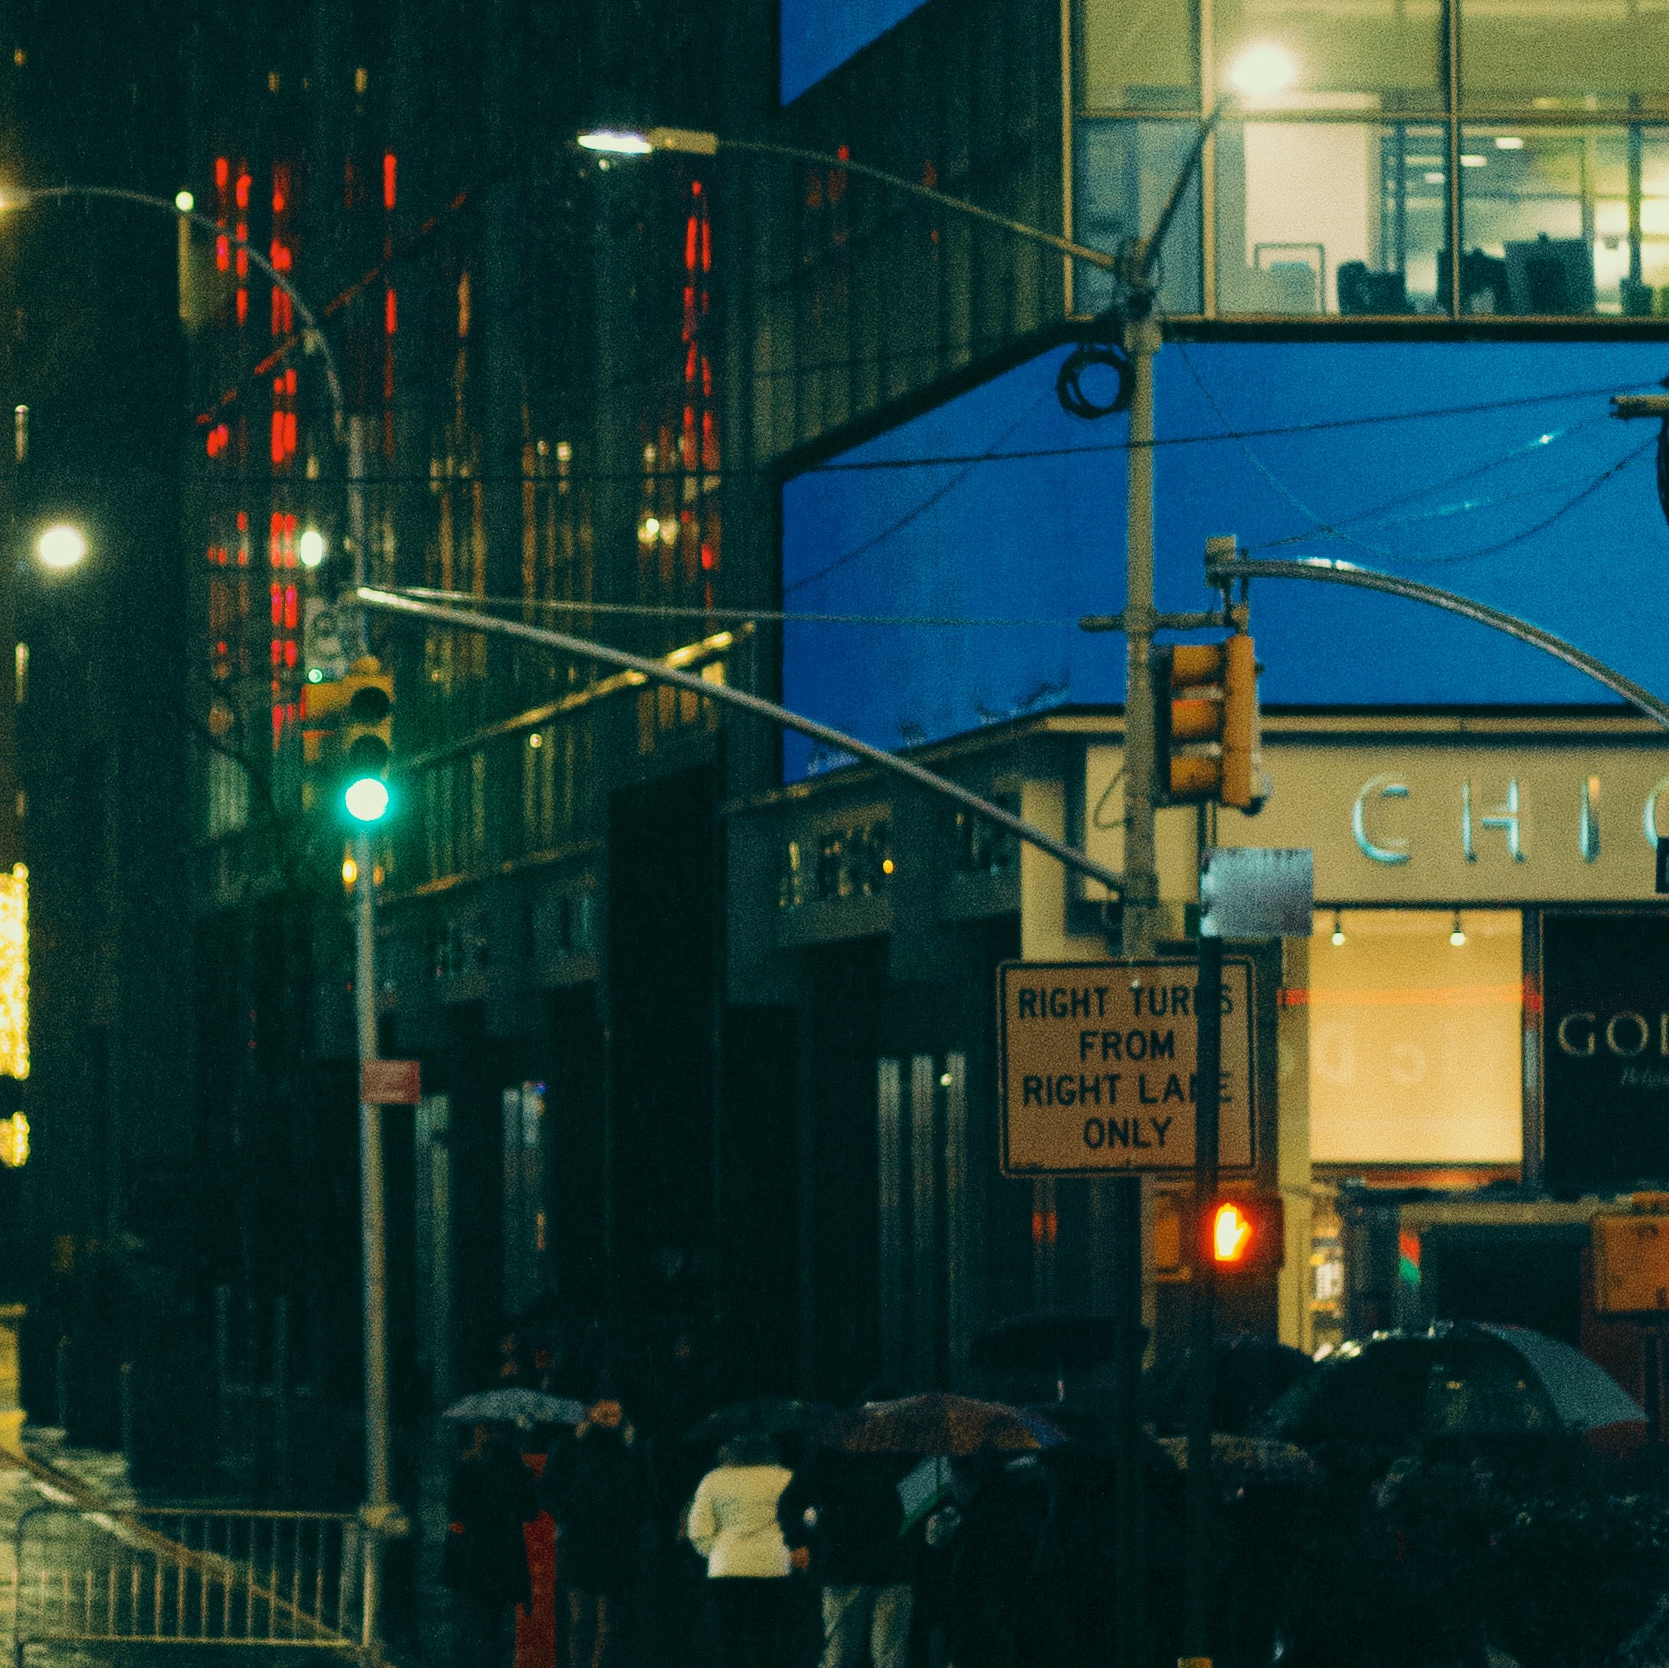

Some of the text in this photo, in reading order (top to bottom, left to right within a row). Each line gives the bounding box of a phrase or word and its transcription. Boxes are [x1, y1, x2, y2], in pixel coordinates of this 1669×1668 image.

[1018, 986, 1108, 1019] RIGHT
[1080, 1029, 1175, 1062] FROM
[1557, 1011, 1669, 1057] GO
[1022, 1073, 1121, 1106] RIGHT
[1082, 1116, 1173, 1150] ONLY
